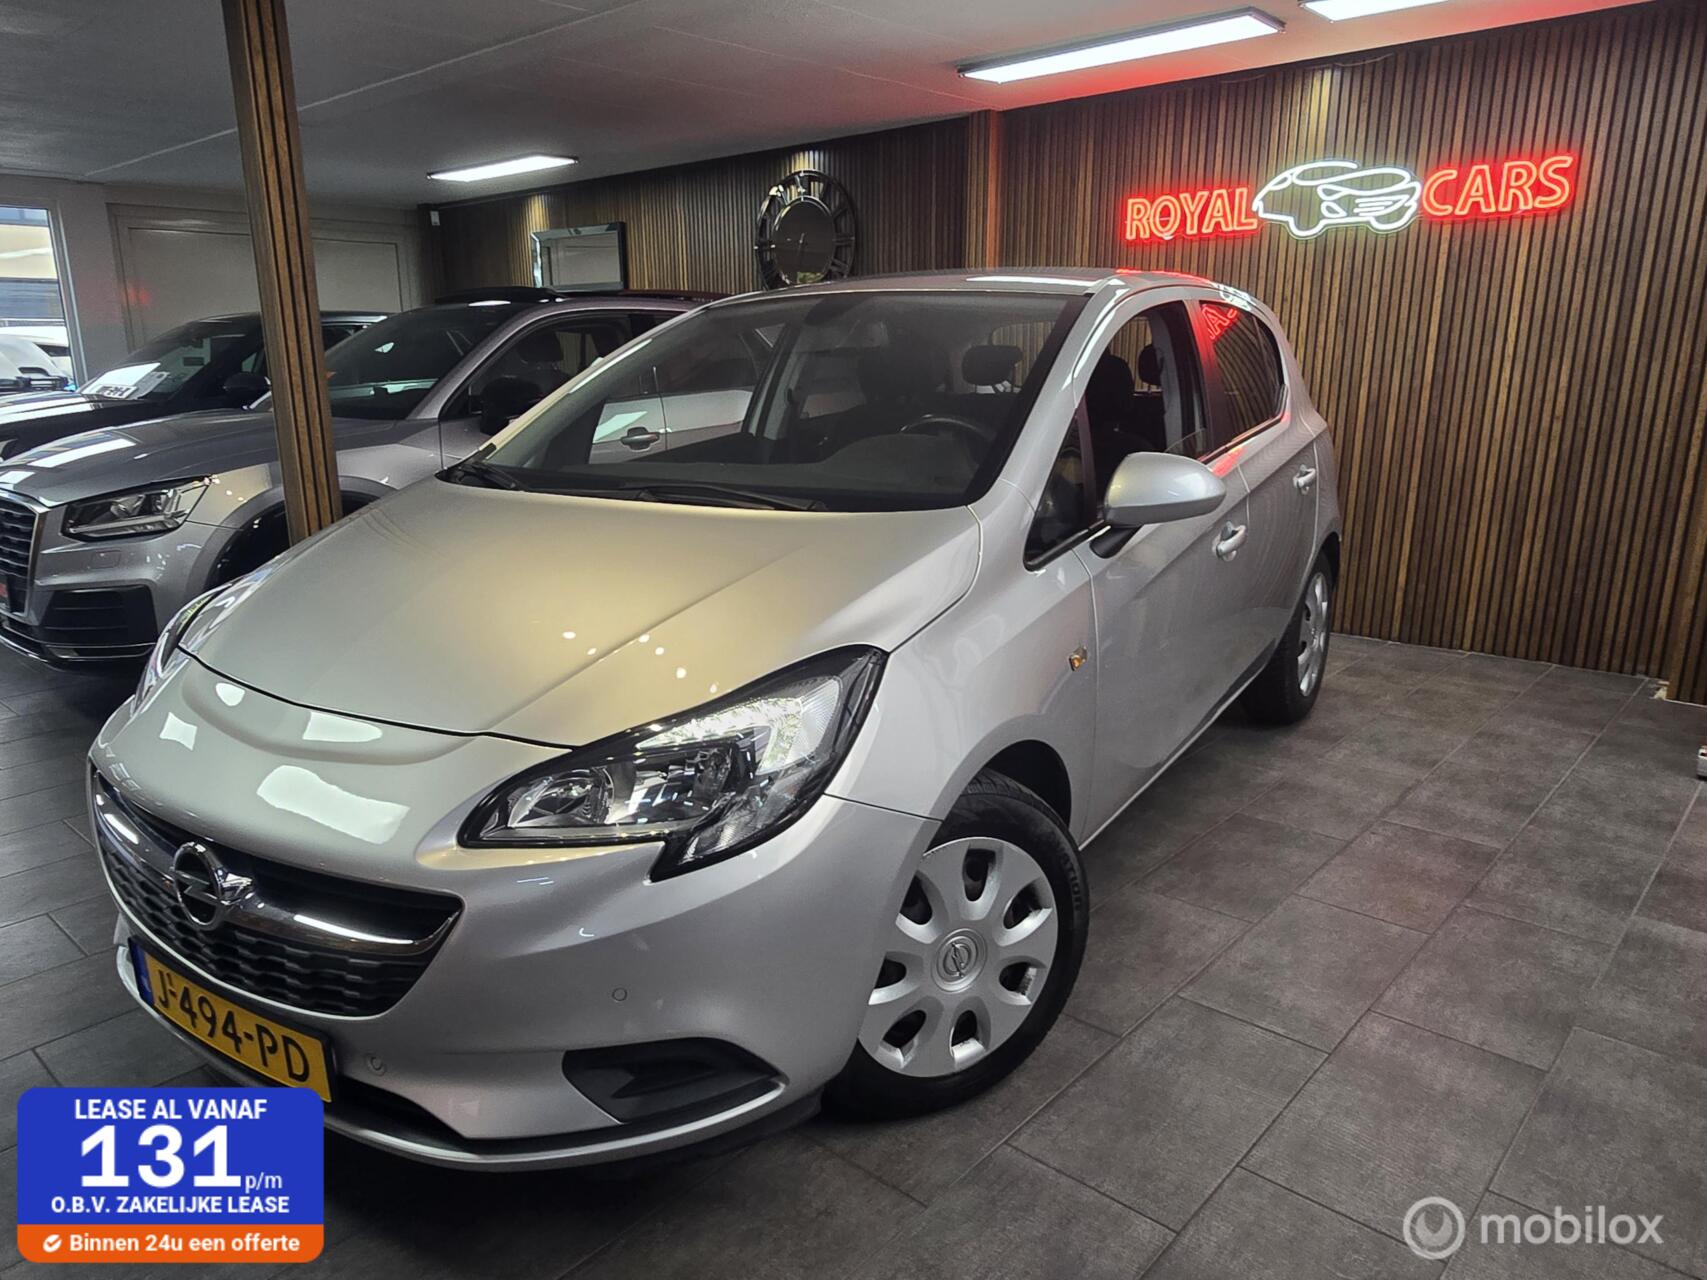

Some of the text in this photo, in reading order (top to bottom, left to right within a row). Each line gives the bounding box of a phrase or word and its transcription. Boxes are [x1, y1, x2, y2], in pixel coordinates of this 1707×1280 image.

[1125, 155, 1573, 240] ROYAL CARS
[157, 969, 311, 1083] J-494-PD
